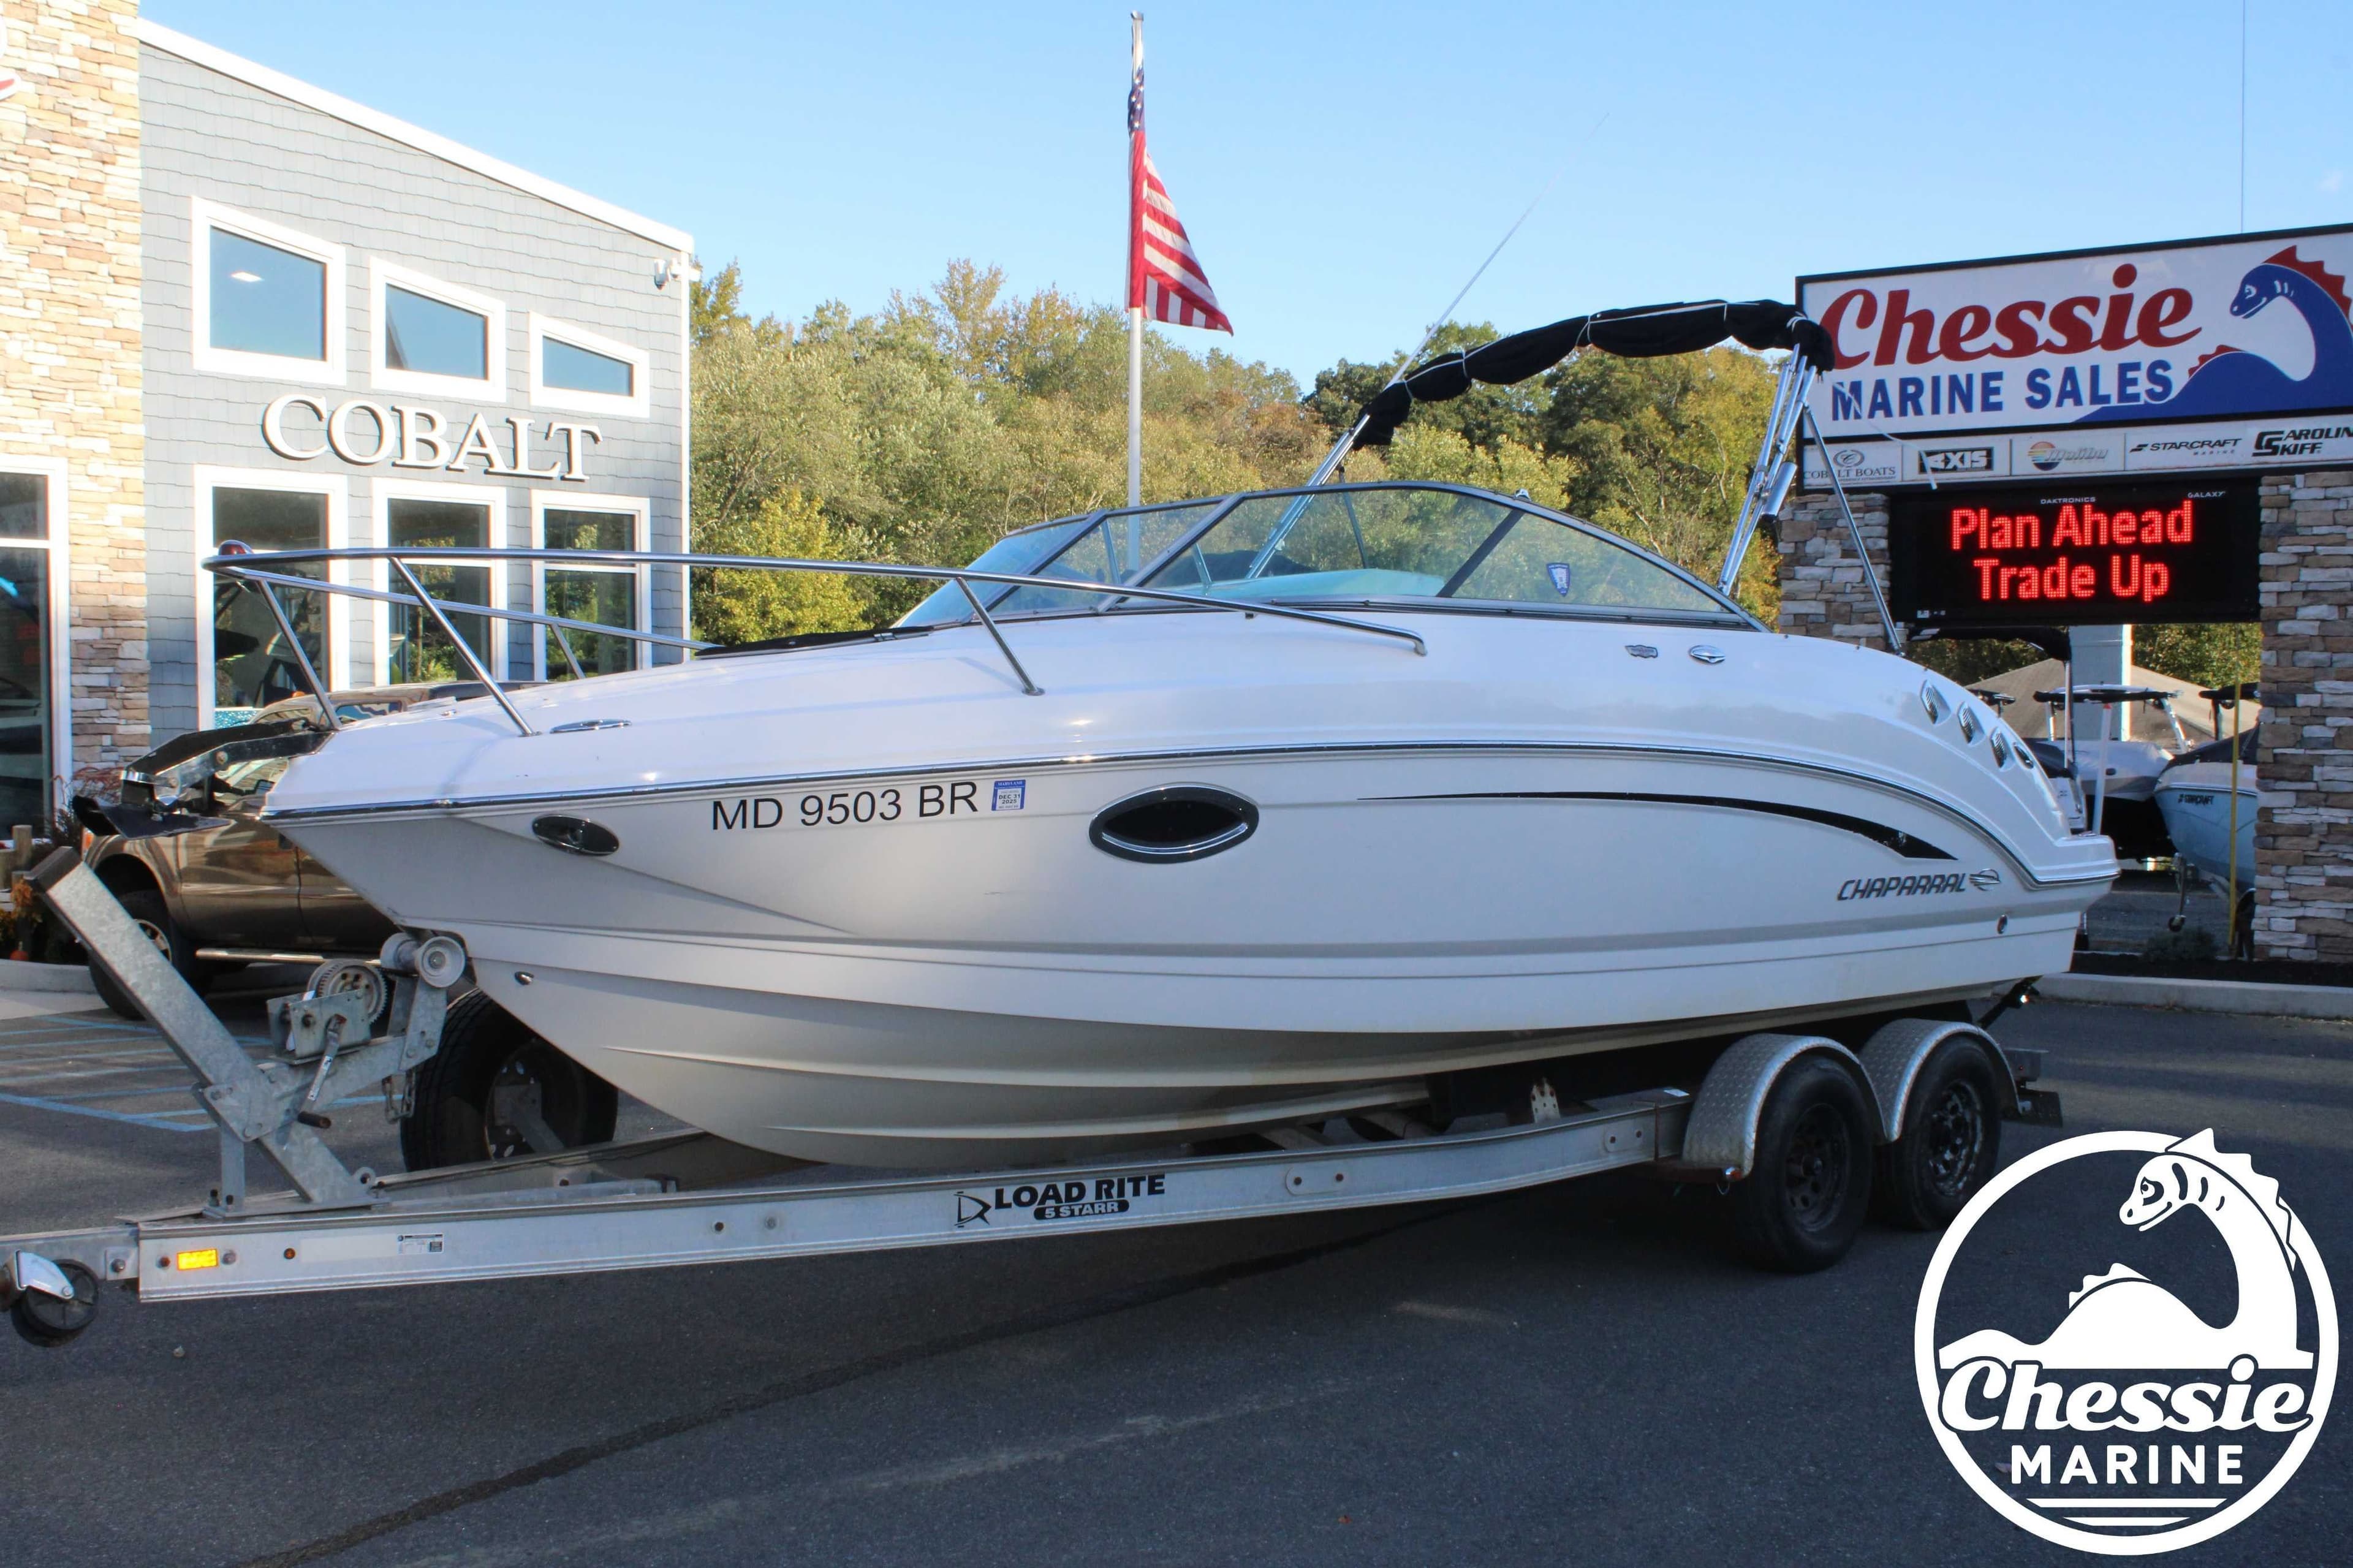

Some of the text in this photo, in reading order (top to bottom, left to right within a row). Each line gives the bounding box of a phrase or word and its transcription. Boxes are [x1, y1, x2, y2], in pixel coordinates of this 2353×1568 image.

[1819, 263, 2202, 370] Chessie
[1832, 359, 2173, 422] MARINE SALES
[262, 394, 604, 481] COBALT
[2150, 438, 2242, 452] STARCRAFT
[1803, 469, 1852, 479] COBLT
[1855, 466, 1896, 477] BOATS
[1927, 450, 1989, 470] AXIS
[1951, 500, 2192, 550] Plan Ahead
[1973, 555, 2170, 602] Trade Up
[712, 781, 979, 830] MD 9503 BR
[1837, 873, 1966, 901] CHAPARRAL
[995, 1174, 1165, 1210] LOAD RITE
[1045, 1201, 1119, 1219] 5 STARR
